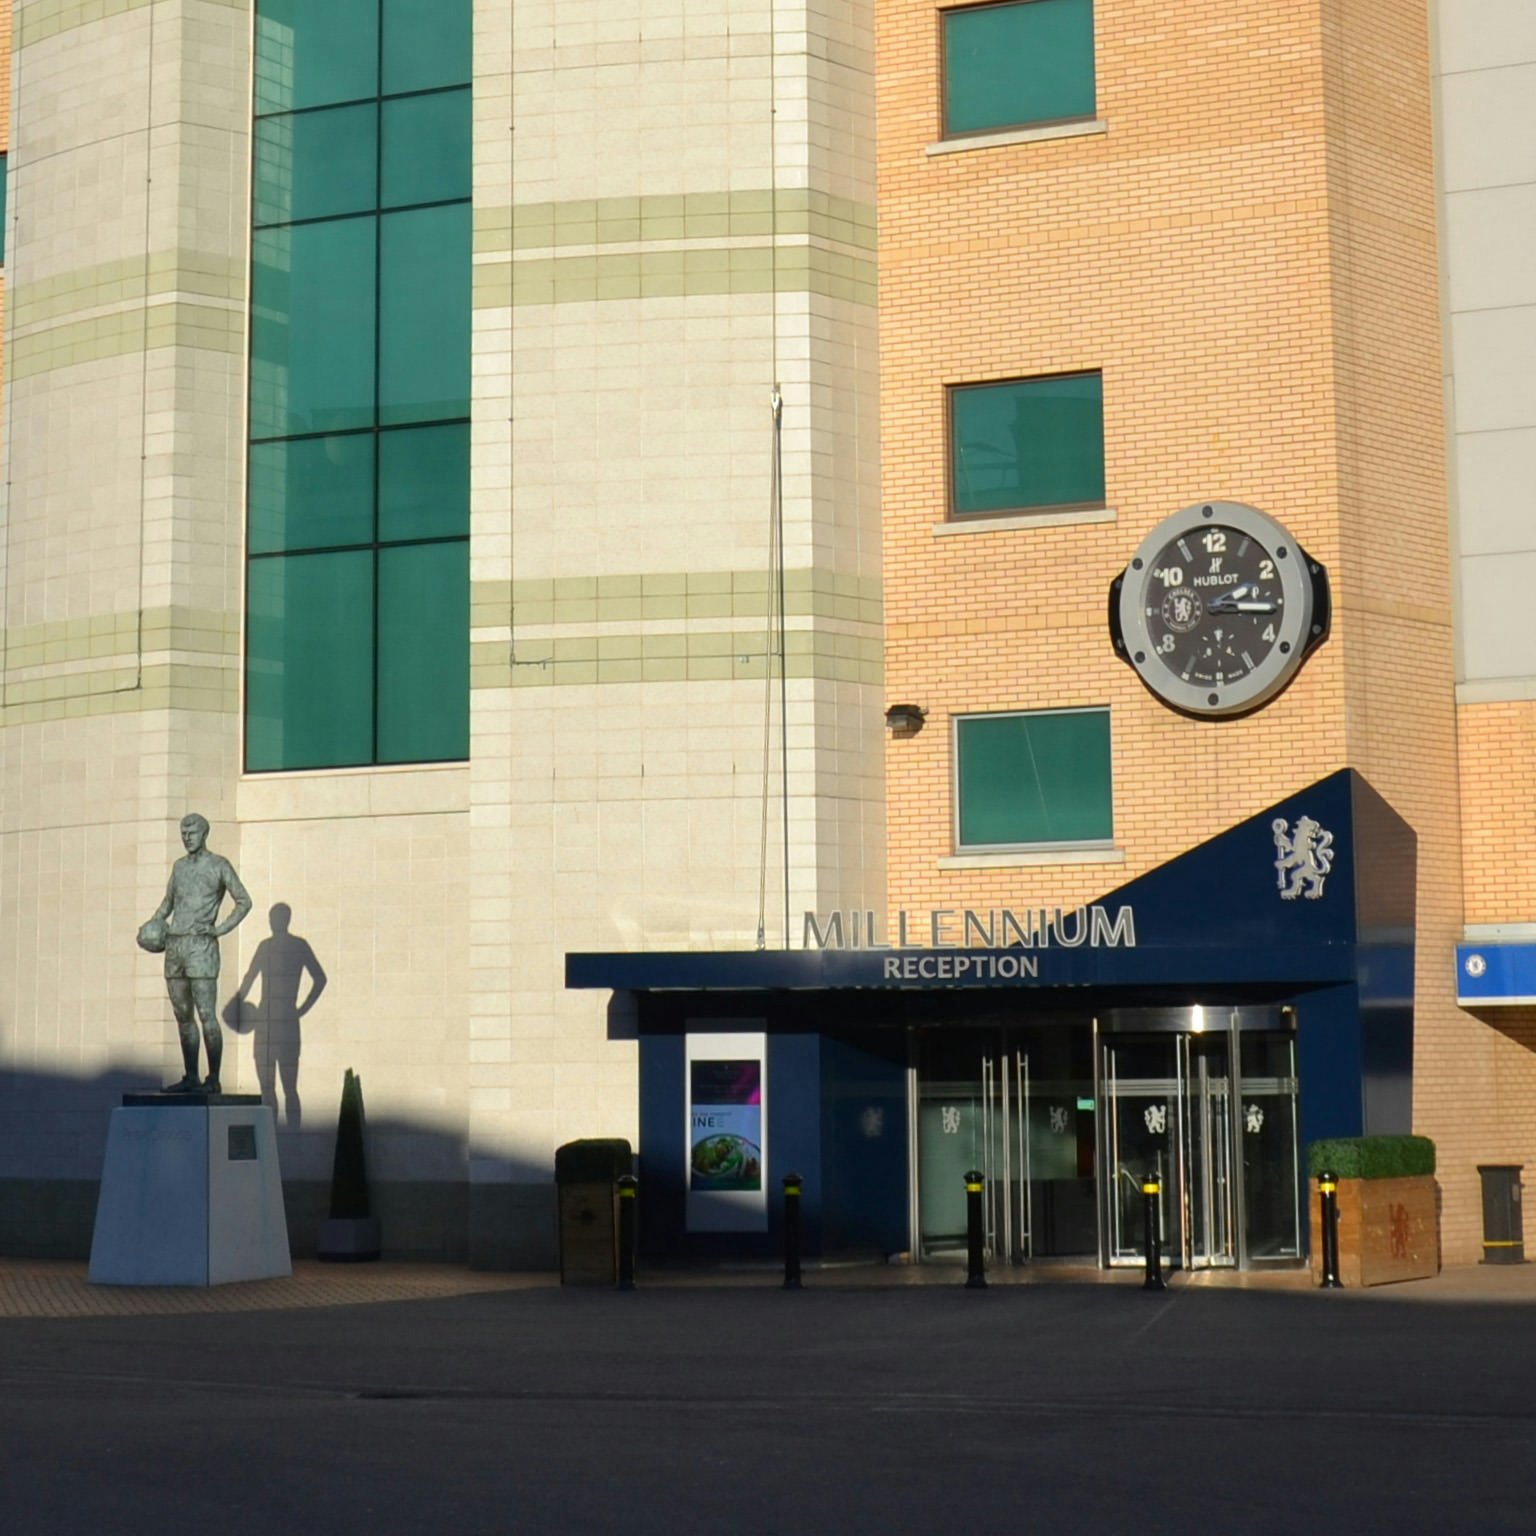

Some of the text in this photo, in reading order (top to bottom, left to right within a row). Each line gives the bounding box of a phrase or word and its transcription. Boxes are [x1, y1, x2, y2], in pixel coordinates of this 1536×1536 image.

[1202, 533, 1227, 553] 12
[1160, 560, 1274, 587] 10 2
[1193, 573, 1240, 586] HUBLOT
[1162, 623, 1276, 652] 8 4
[802, 905, 1137, 949] MILLENNIUM
[884, 955, 1039, 980] RECEPTION
